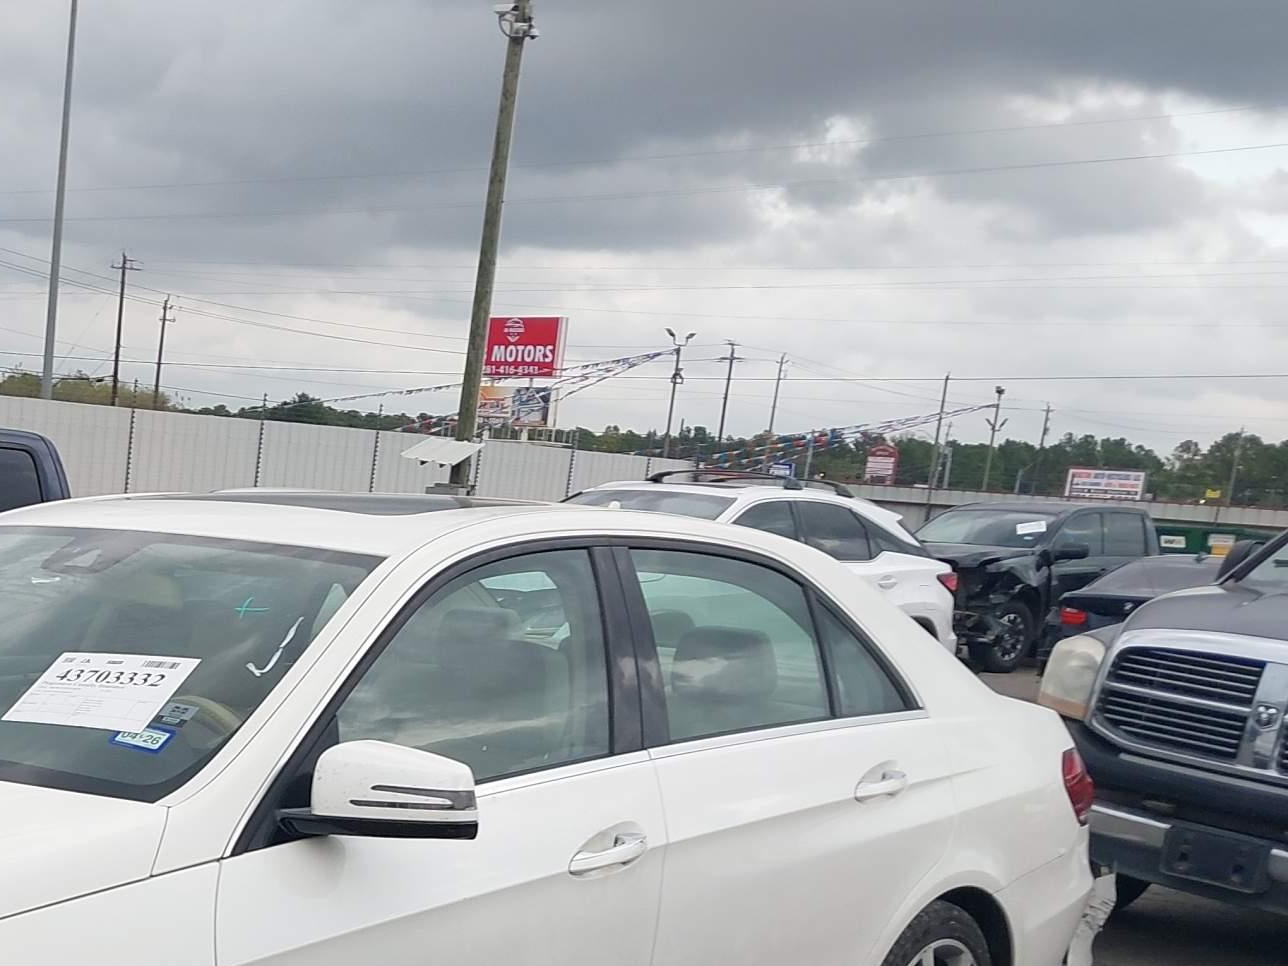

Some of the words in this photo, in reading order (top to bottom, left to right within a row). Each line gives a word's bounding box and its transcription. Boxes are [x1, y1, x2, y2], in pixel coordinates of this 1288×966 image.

[491, 345, 554, 362] MOTORS
[56, 668, 166, 687] 43703332
[142, 734, 162, 745] 26
